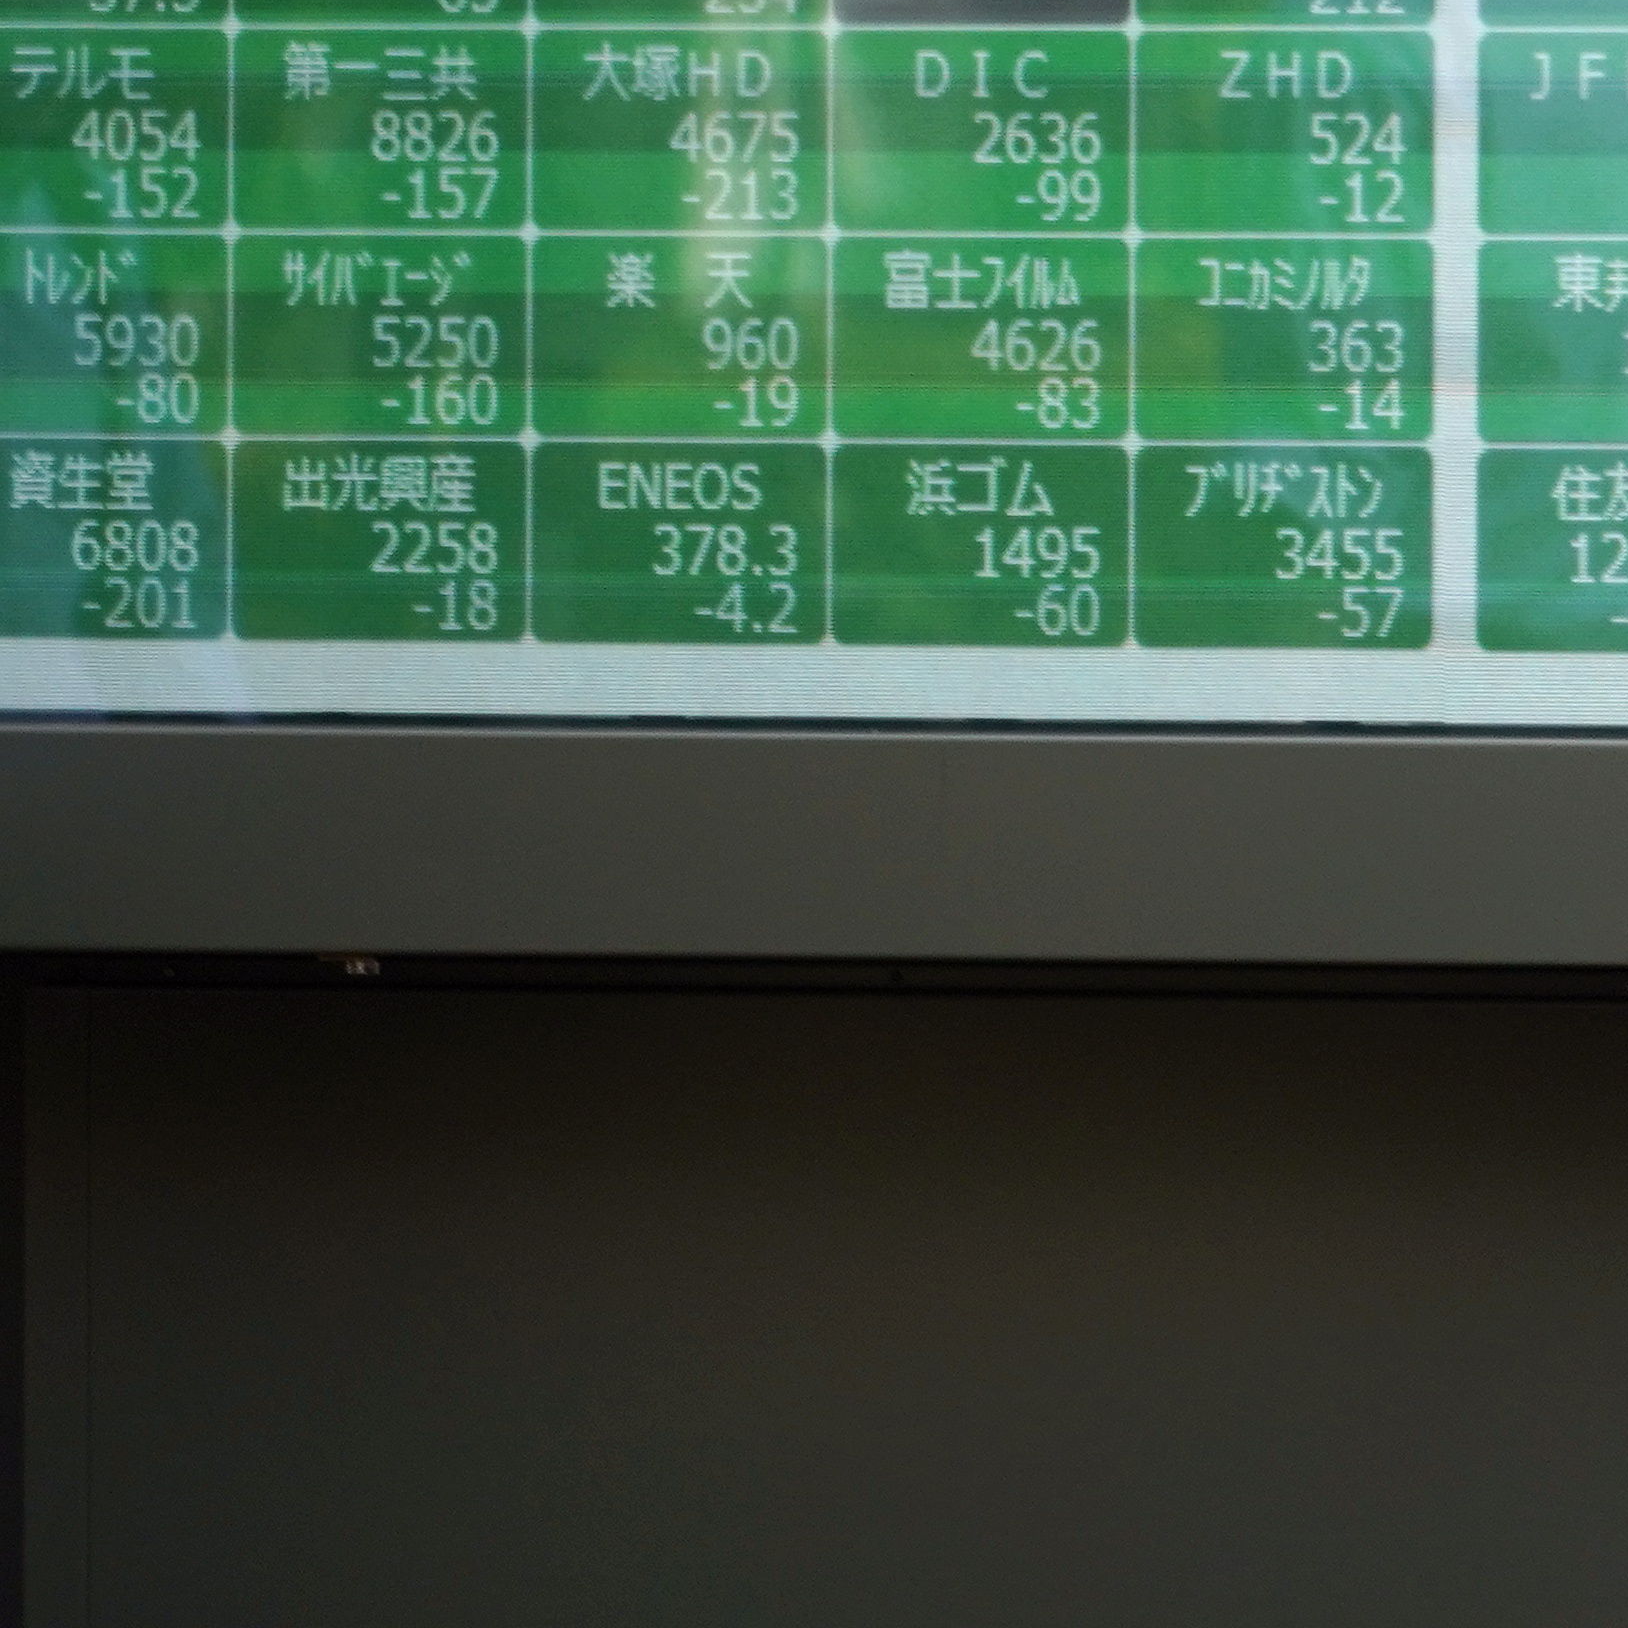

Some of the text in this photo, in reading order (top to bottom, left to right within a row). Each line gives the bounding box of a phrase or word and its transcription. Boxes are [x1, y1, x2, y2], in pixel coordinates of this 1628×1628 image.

[11, 46, 153, 100] テルモ
[284, 41, 475, 100] 第一三共
[72, 109, 199, 165] 4054
[371, 110, 498, 165] 8826
[84, 166, 199, 220] -152
[381, 167, 498, 220] -157
[11, 451, 153, 510] 資生堂
[283, 454, 474, 512] 出光興産
[599, 461, 761, 511] ENEOS
[907, 457, 1053, 517] 浜ゴム
[71, 519, 198, 572] 6808
[371, 521, 497, 574] 2258
[653, 523, 797, 576] 378.3
[976, 526, 1099, 579] 1495
[83, 576, 195, 629] -201
[413, 579, 497, 631] -18
[695, 581, 797, 633] -4.2
[1015, 583, 1100, 636] -60
